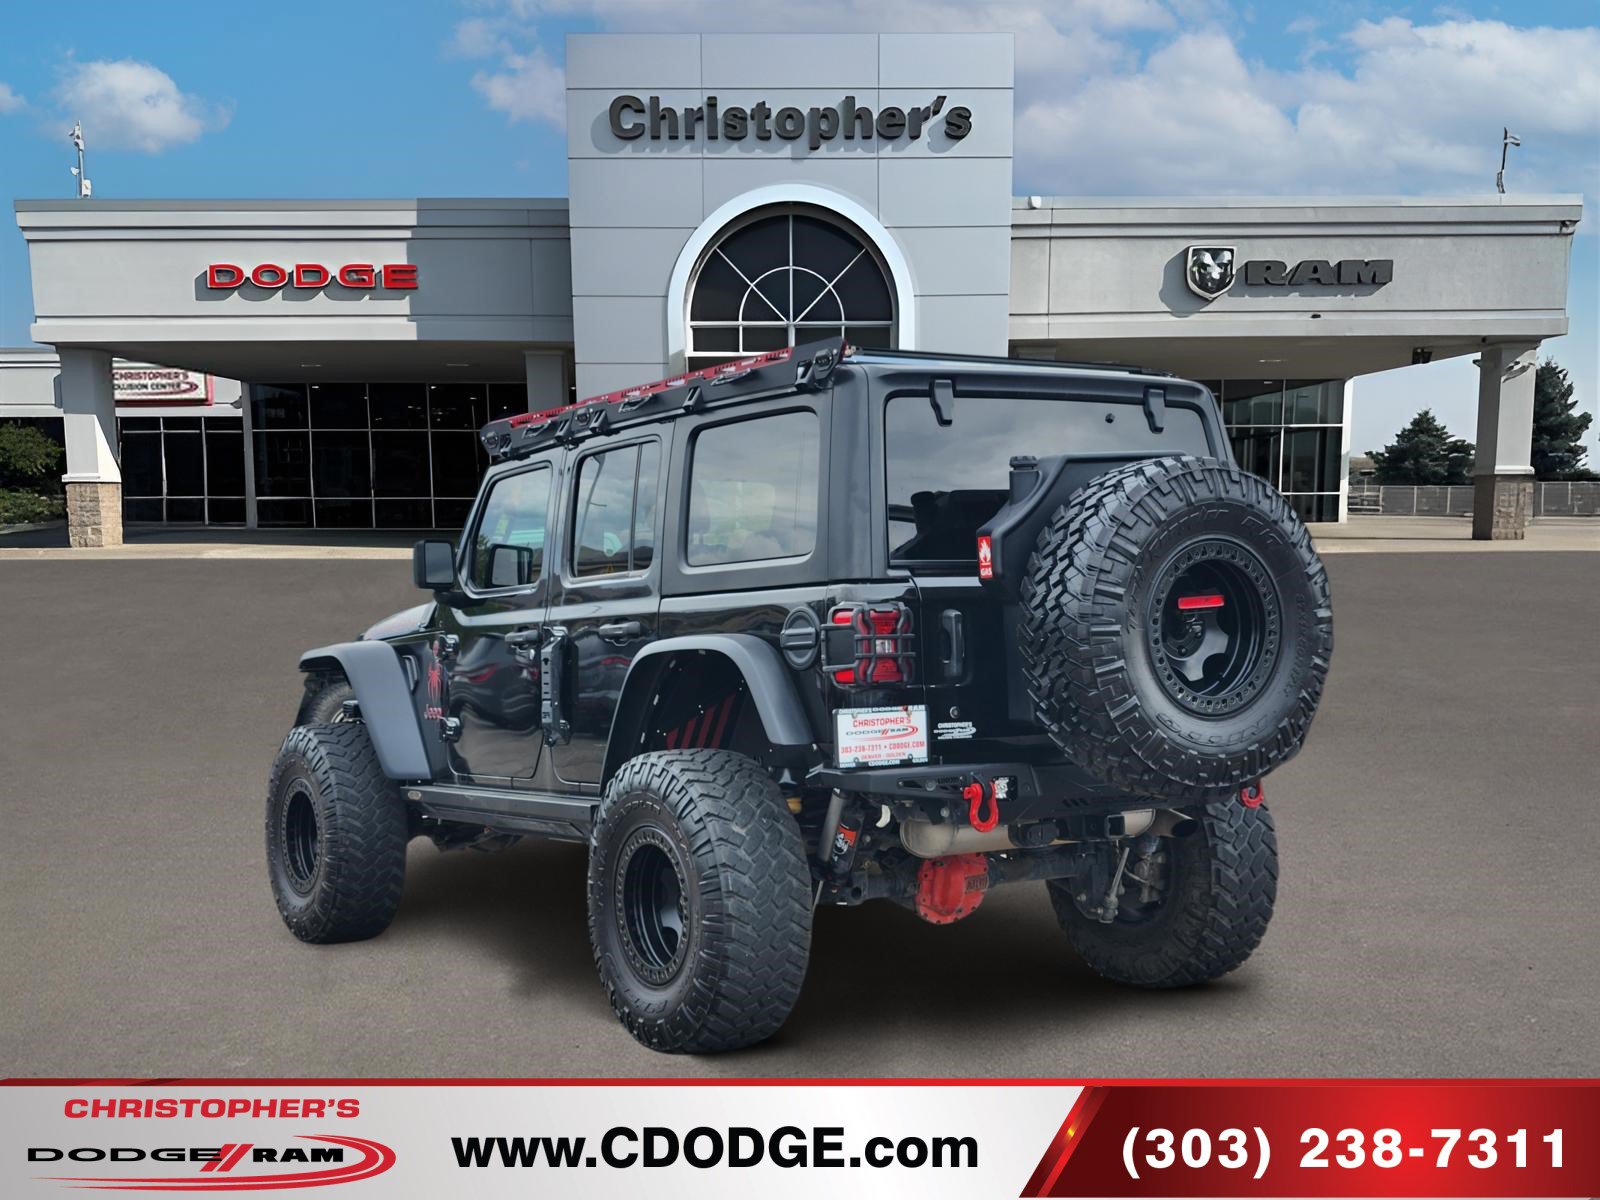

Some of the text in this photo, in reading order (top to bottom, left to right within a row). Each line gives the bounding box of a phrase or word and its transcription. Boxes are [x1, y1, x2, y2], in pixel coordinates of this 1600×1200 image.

[608, 95, 972, 150] Christopher's
[207, 263, 418, 289] DODGE
[1246, 260, 1393, 285] RAM
[113, 382, 181, 391] OLLISION CENTER
[980, 567, 992, 576] GAS
[424, 704, 442, 720] Jeep
[852, 716, 912, 728] CHRISTOPHER'S
[888, 741, 925, 751] CDODGE.COM
